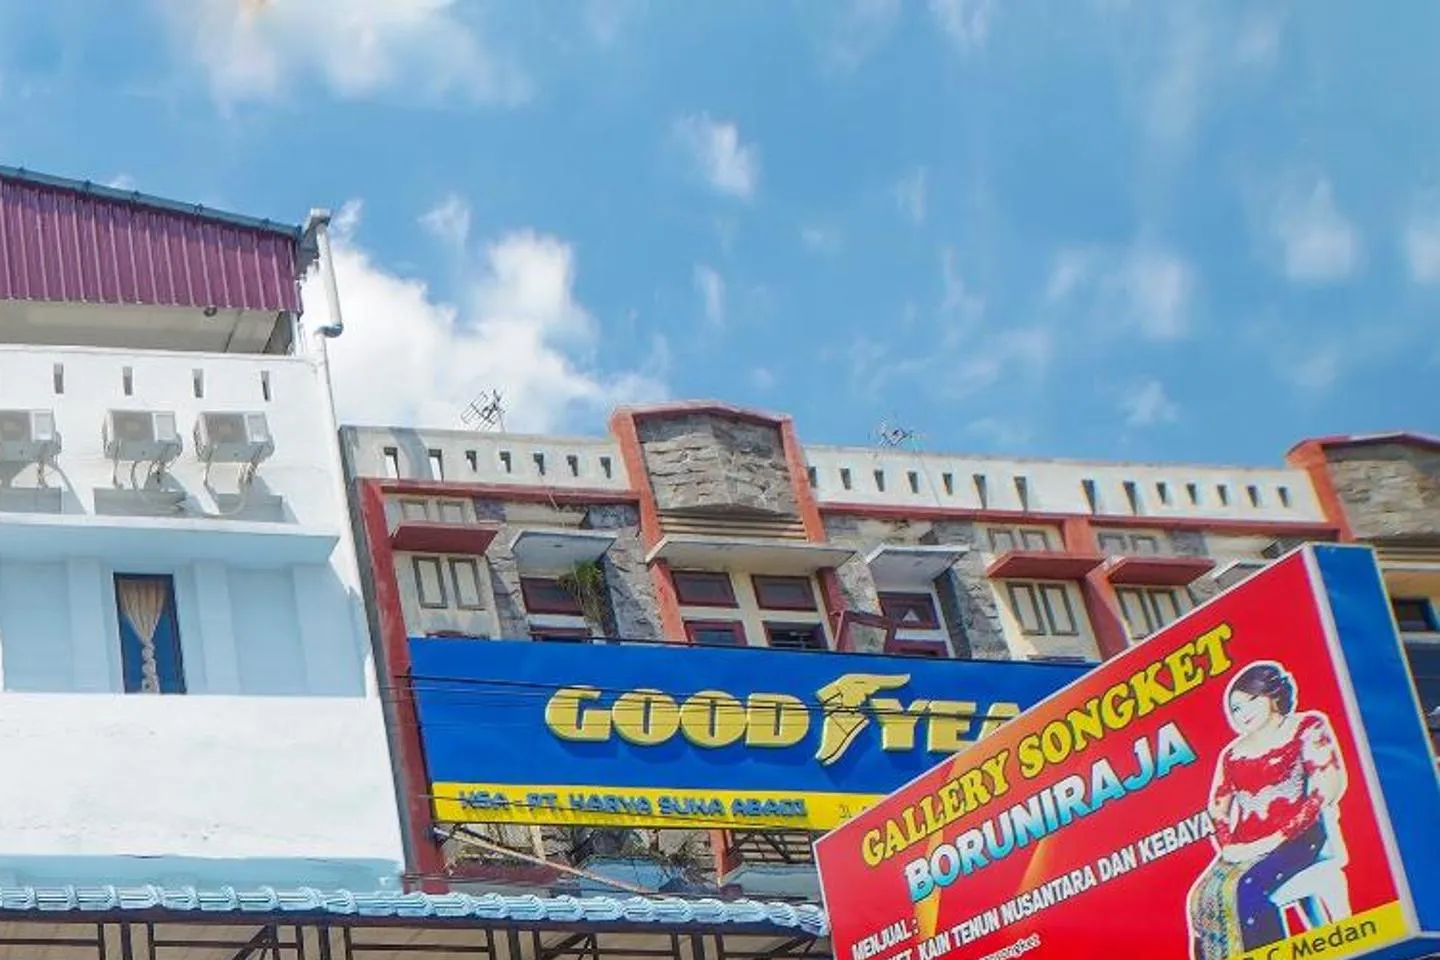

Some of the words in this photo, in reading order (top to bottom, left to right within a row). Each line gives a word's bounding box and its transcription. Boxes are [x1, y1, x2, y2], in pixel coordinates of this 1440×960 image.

[861, 749, 1010, 867] GALLERY
[1017, 623, 1233, 781] SONGKET
[904, 722, 1198, 903] BORUNIRAJA
[951, 908, 1000, 948] TENUN
[1000, 865, 1098, 925] NUSANTARA
[1097, 845, 1138, 881] DAN
[1138, 811, 1216, 863] KEBAYA
